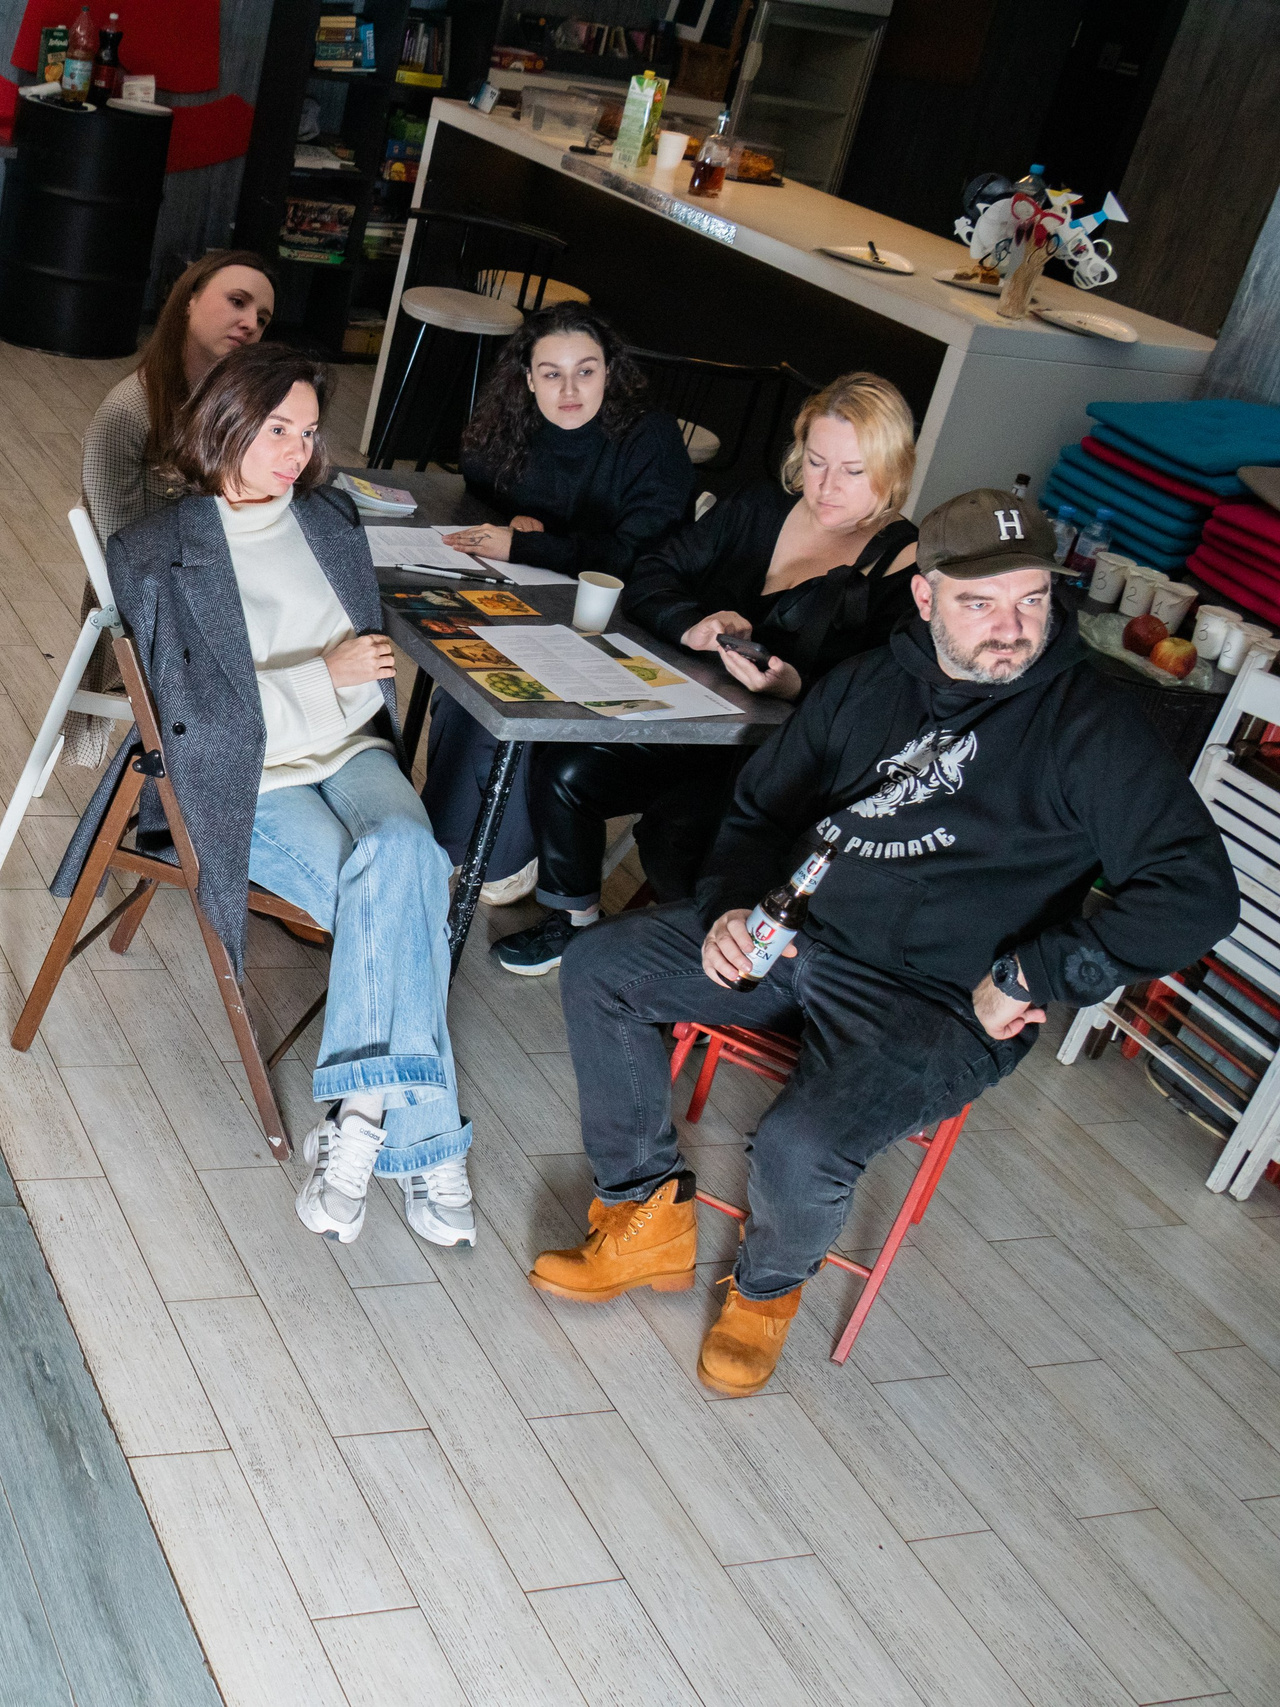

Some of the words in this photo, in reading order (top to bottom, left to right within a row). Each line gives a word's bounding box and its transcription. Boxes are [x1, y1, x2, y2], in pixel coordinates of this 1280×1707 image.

[994, 509, 1025, 541] H
[1094, 570, 1107, 591] 3
[1125, 586, 1139, 605] 2
[1153, 600, 1164, 615] 1
[1196, 622, 1210, 642] 3
[1222, 641, 1234, 659] 2
[844, 826, 957, 859] PRIMATE
[359, 1127, 381, 1142] adidas
